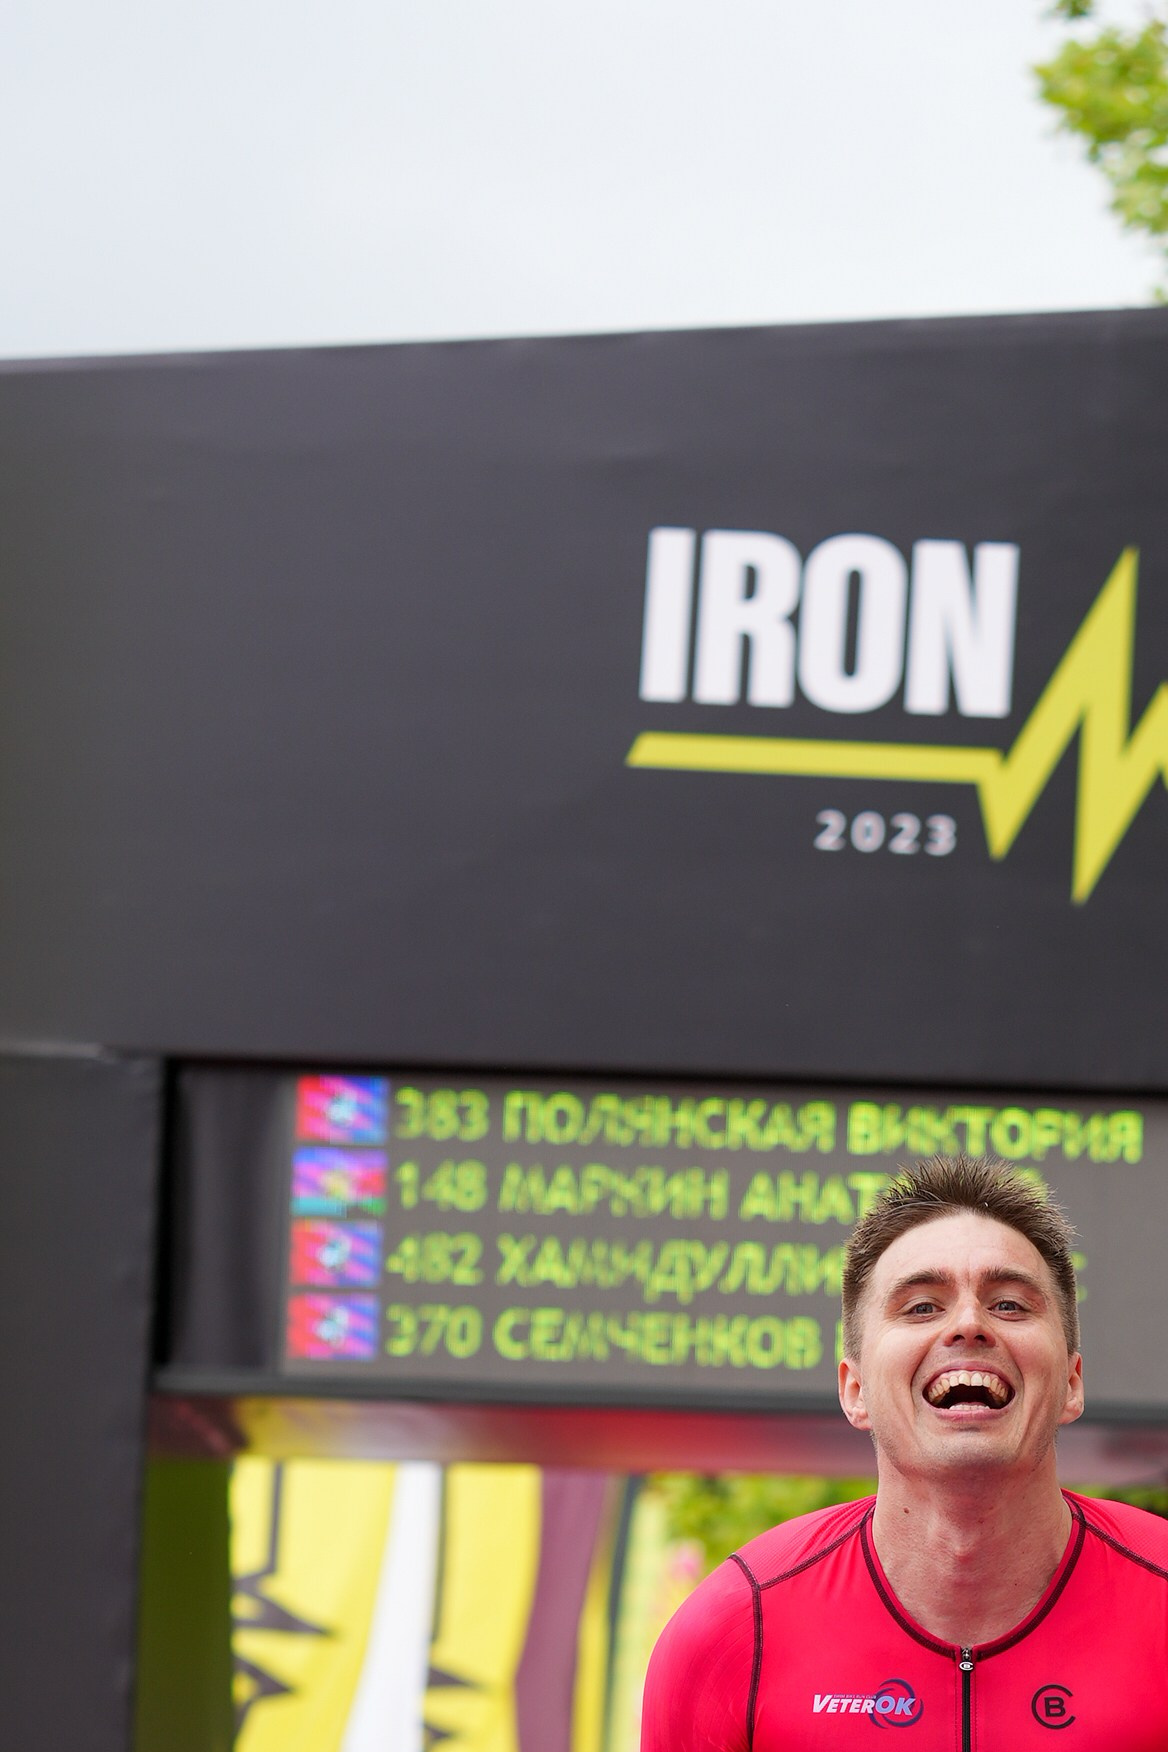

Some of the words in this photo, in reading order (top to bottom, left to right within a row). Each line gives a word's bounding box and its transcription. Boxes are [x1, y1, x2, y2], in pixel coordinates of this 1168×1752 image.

[639, 526, 1020, 718] IRON
[814, 809, 958, 857] 2023
[395, 1086, 490, 1141] 383
[502, 1090, 837, 1154] ПОЛЯНСКАЯ
[846, 1100, 1145, 1165] ВИКТОРИЯ
[396, 1159, 488, 1212] 148
[385, 1231, 484, 1287] 482
[495, 1233, 844, 1305] ХАМИДУЛЛИ
[384, 1304, 483, 1360] 370
